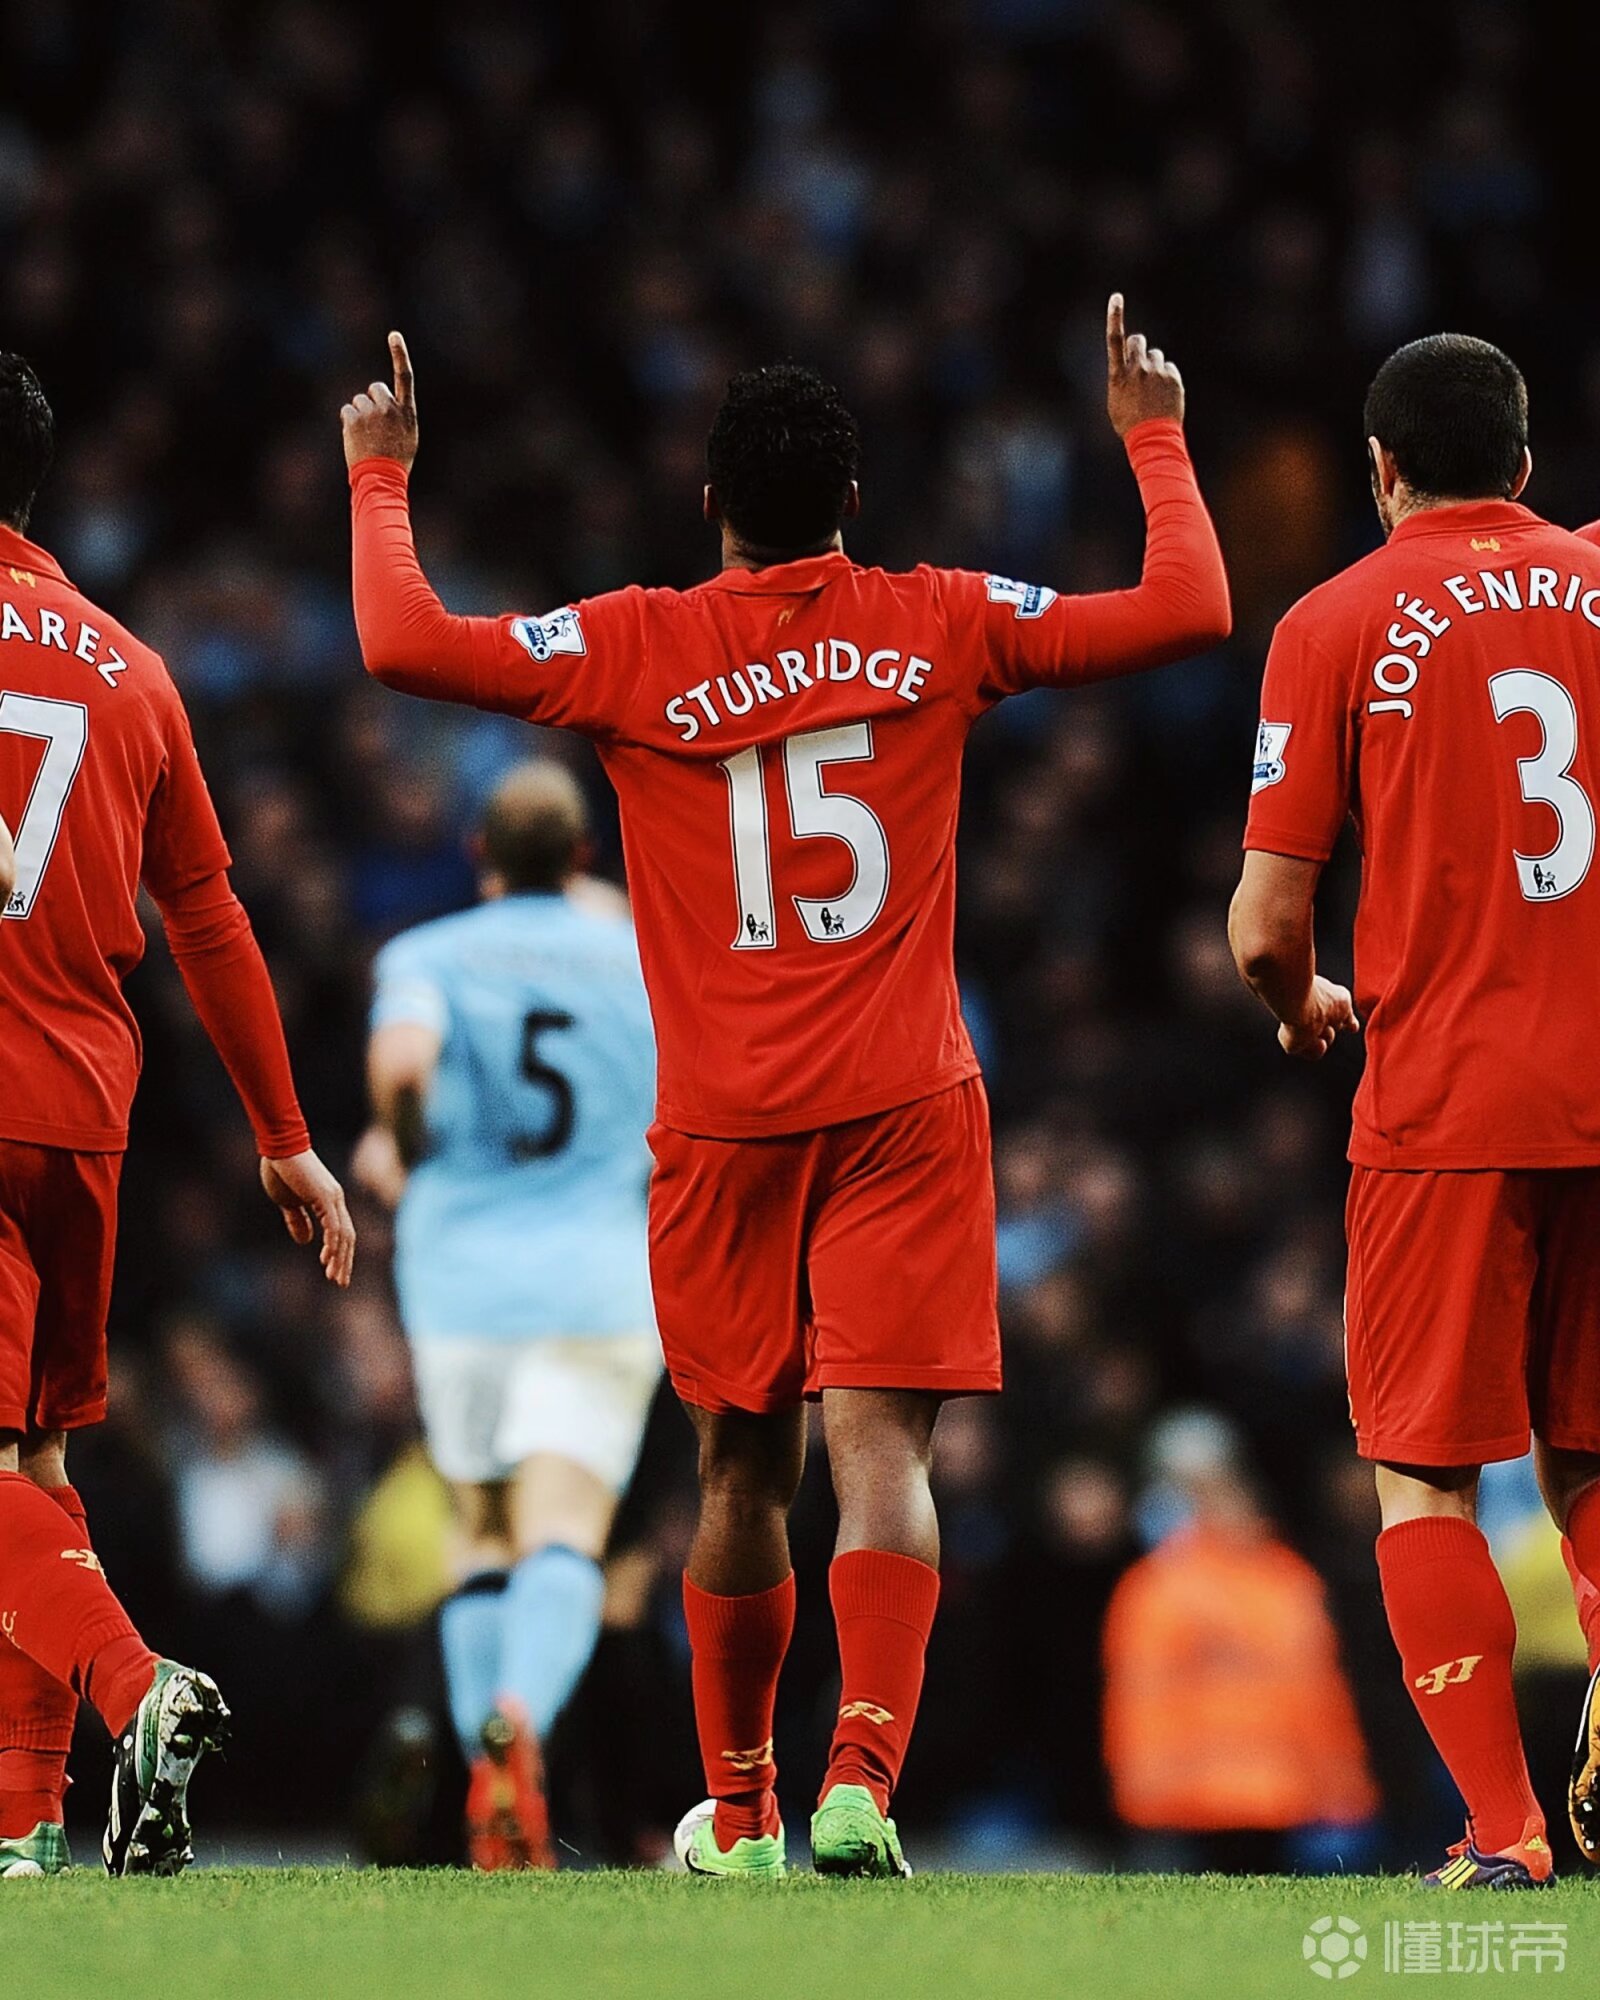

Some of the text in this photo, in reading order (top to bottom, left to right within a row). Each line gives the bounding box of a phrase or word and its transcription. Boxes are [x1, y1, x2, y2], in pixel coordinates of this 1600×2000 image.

[665, 638, 932, 742] STURRIDGE
[1369, 592, 1451, 719] JOSÉ
[0, 690, 88, 920] 7
[717, 720, 890, 950] 15
[1488, 668, 1596, 901] 3
[504, 1007, 577, 1163] 5
